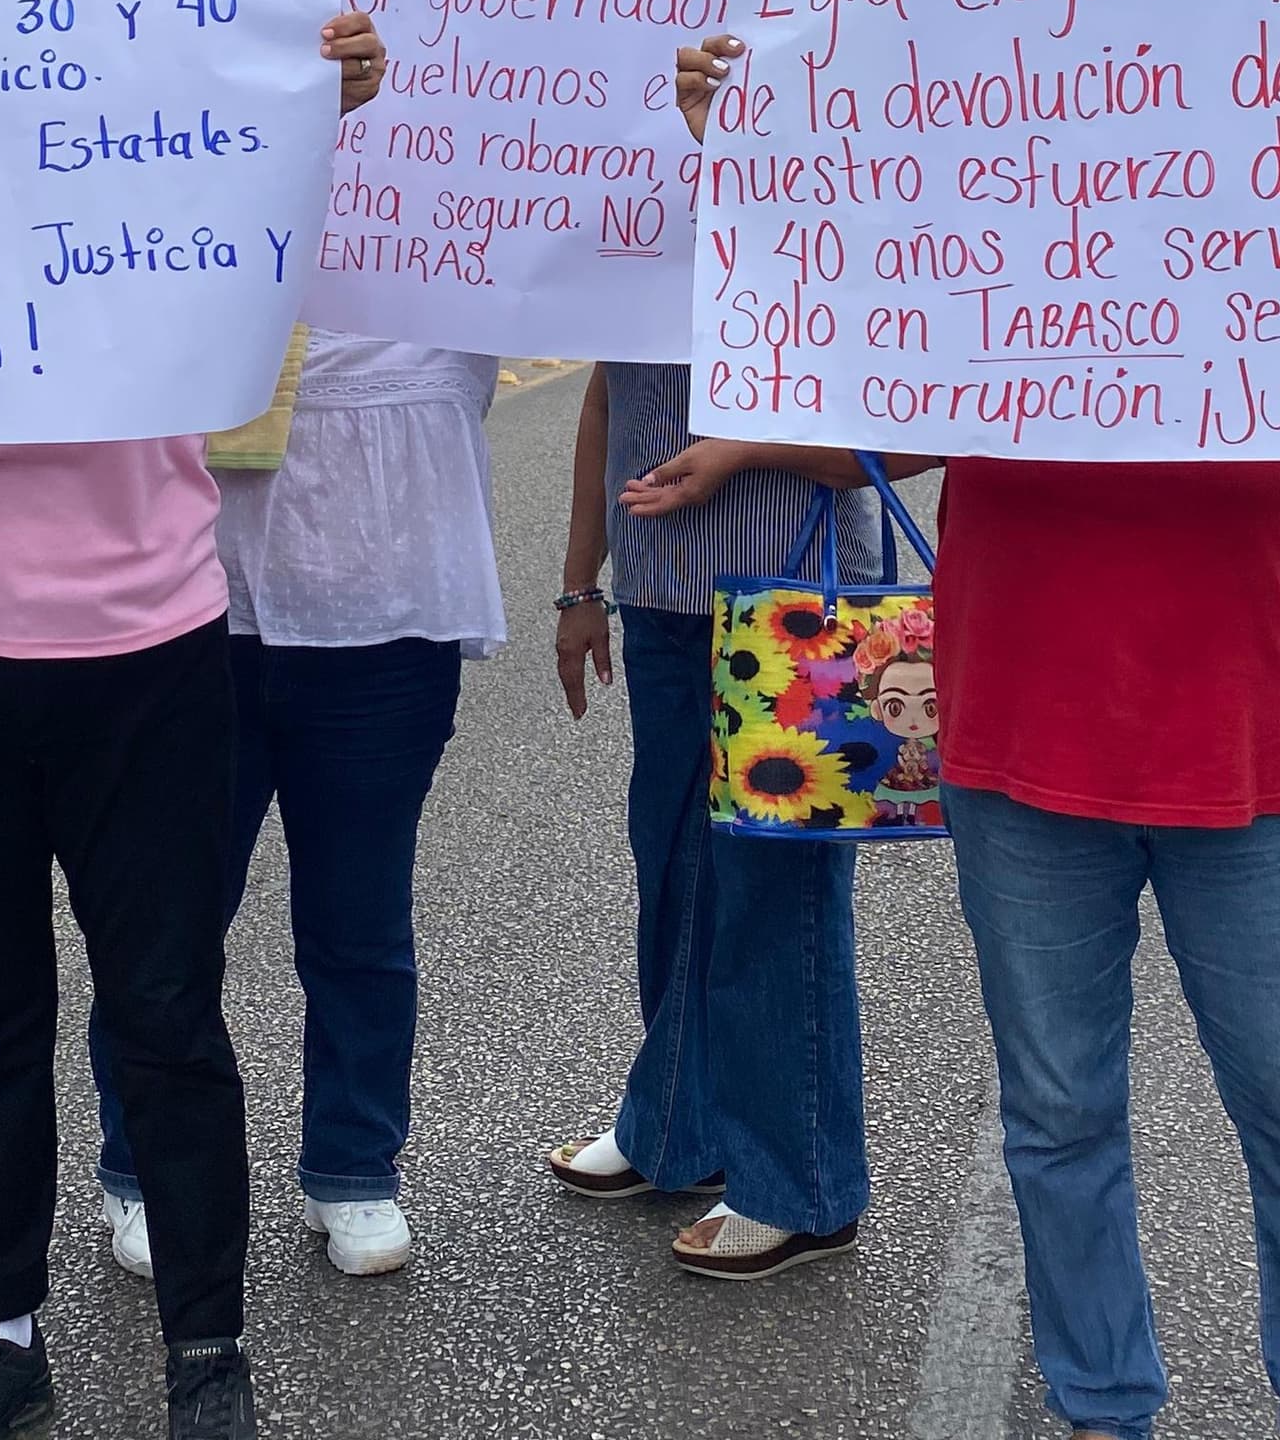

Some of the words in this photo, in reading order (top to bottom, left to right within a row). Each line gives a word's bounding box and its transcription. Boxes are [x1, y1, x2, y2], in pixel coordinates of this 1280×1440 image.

[385, 36, 609, 108] uelvanos
[718, 47, 775, 137] de
[803, 50, 861, 133] la
[883, 39, 1193, 133] devolución
[388, 122, 454, 165] nos
[710, 135, 923, 207] nuestro
[959, 135, 1216, 209] esfuerzo
[331, 162, 401, 225] cha
[32, 220, 238, 287] Justicia
[320, 231, 495, 286] ENTIRAS.
[710, 224, 738, 302] y
[772, 219, 846, 285] 40
[875, 223, 1006, 284] años
[1043, 206, 1120, 282] de
[866, 307, 928, 352] en
[948, 282, 1181, 353] TABASCO
[709, 345, 824, 414] esta
